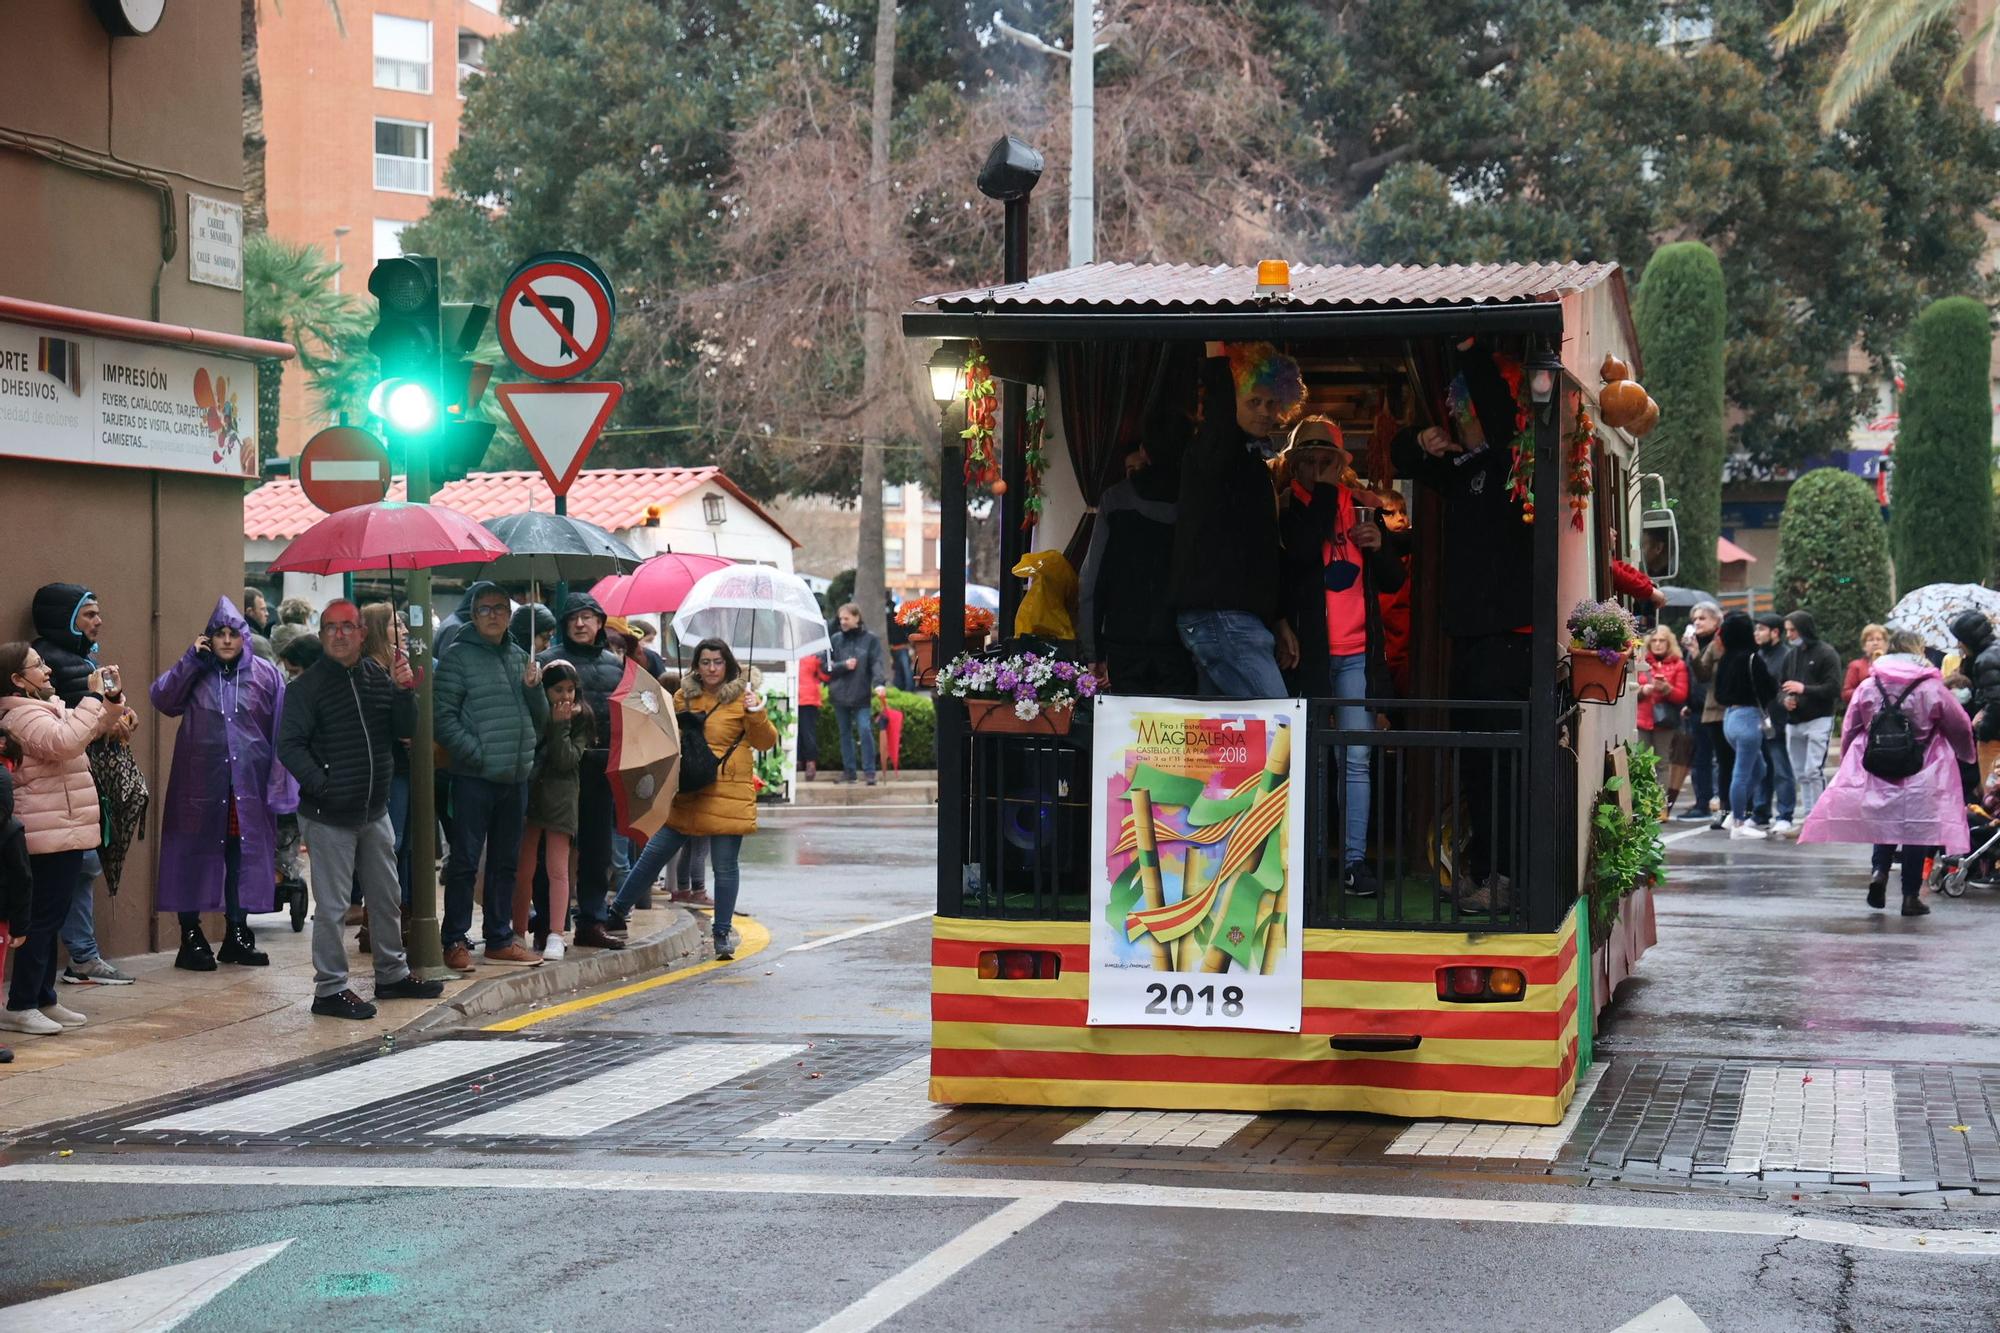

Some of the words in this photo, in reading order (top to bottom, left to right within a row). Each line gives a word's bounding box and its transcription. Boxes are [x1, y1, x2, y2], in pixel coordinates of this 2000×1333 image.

[102, 363, 168, 391] IMPRESIÓN
[102, 392, 130, 409] FLYERS,
[131, 396, 174, 416] CATÁLOGOS,
[102, 411, 136, 428] TARJETAS
[138, 417, 148, 430] DE
[150, 419, 172, 433] VISITA,
[173, 422, 199, 437] CARTAS
[1137, 719, 1246, 746] MAGDALENA
[1218, 746, 1247, 763] 2018
[1144, 982, 1244, 1018] 2018
